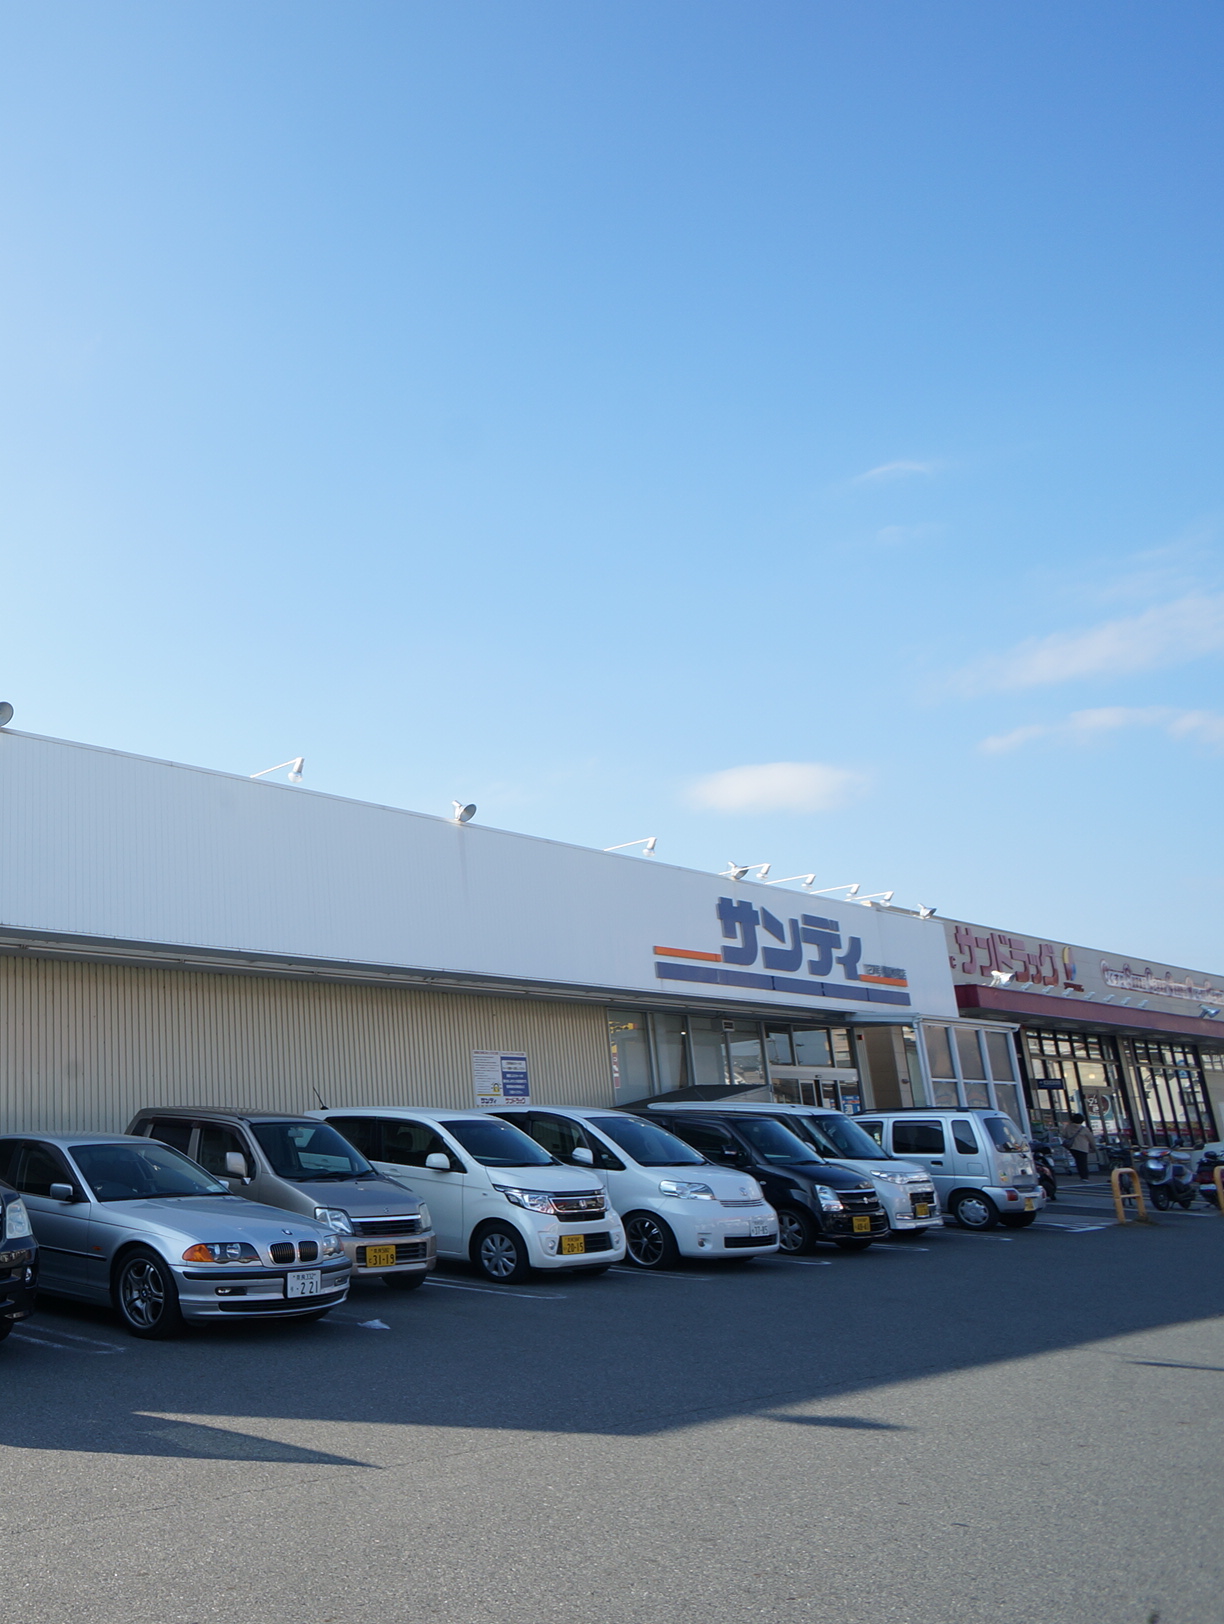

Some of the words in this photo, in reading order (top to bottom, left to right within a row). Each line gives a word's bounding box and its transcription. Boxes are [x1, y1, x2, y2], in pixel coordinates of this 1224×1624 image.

[716, 896, 861, 980] サンディ
[954, 925, 1059, 986] サンドラッグ
[373, 1254, 394, 1265] 31-19
